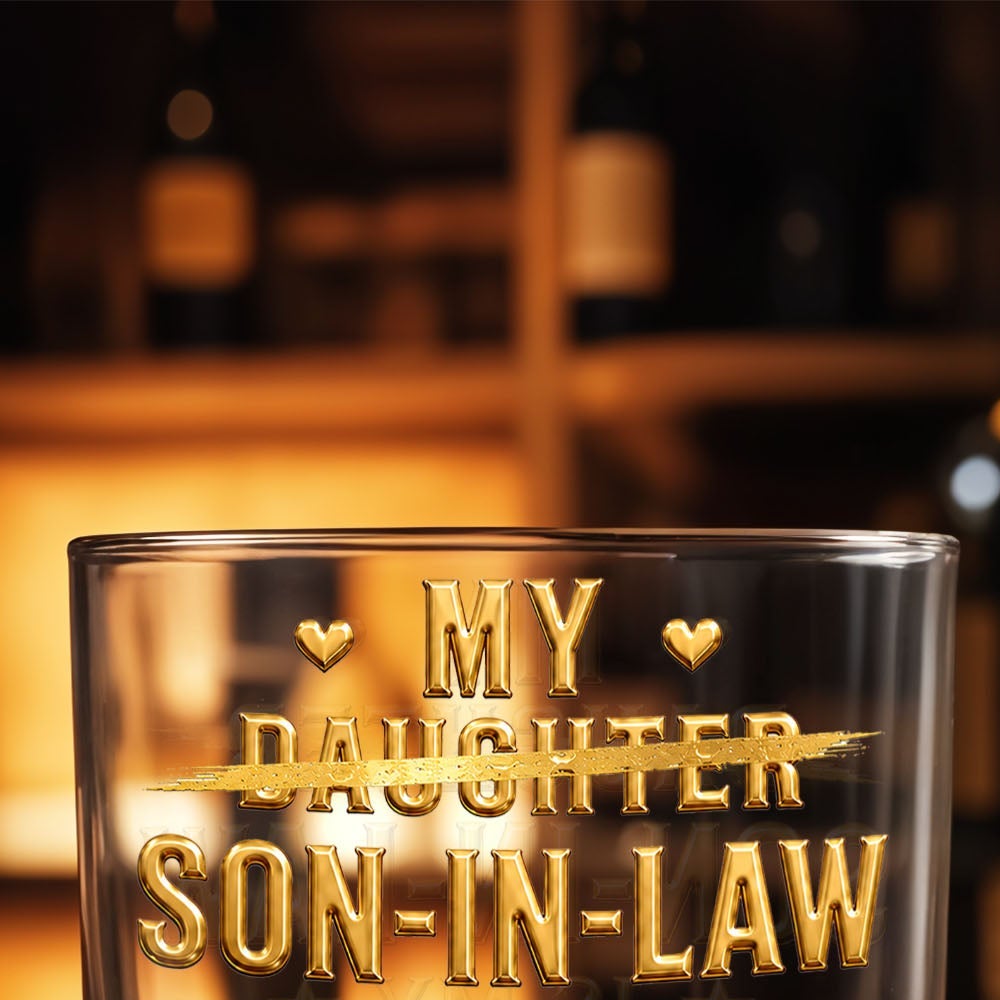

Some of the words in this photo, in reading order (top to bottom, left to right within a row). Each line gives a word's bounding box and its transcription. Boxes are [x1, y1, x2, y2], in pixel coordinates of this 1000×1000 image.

[423, 578, 604, 700] MY
[237, 711, 805, 818] DAUGHTER
[136, 832, 889, 988] SON-IN-LAW
